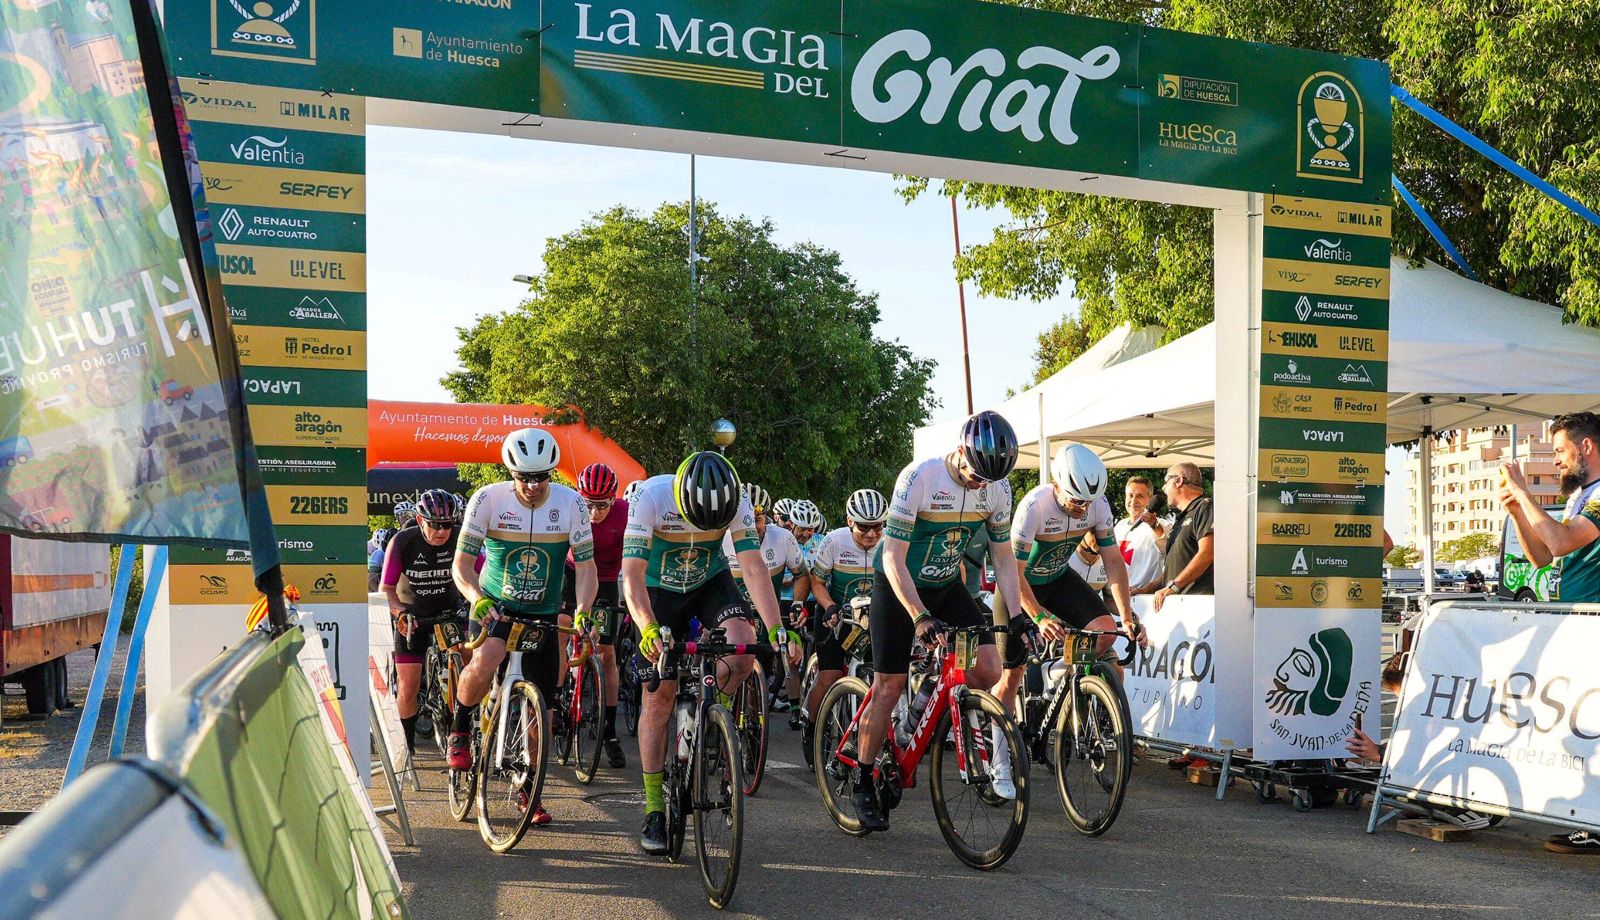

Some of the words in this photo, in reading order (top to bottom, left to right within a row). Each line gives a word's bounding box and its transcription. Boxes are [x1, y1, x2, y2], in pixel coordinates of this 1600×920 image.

[574, 2, 641, 47] La
[426, 31, 523, 55] Ayuntamiento
[426, 48, 443, 61] de
[447, 50, 500, 68] Huesca
[1184, 80, 1230, 93] DIPUTACIÓN
[200, 95, 257, 109] VIDAL
[1184, 89, 1195, 98] DE
[1196, 91, 1230, 102] HUESCA
[298, 103, 351, 122] MILAR
[230, 135, 305, 165] Valentia
[1223, 147, 1238, 155] BICI
[279, 182, 354, 200] SERFEY
[1286, 209, 1323, 219] VIDAL
[1349, 213, 1383, 227] MILAR
[253, 215, 311, 228] RENAULT
[1304, 238, 1352, 261] Valentia
[1335, 275, 1383, 288] SERFEY
[1317, 302, 1354, 311] RENAULT
[302, 343, 345, 356] Pedro
[1273, 372, 1312, 382] podoactiva
[1344, 402, 1373, 412] Pedro
[295, 412, 321, 423] alto
[379, 410, 478, 427] Ayuntamiento
[482, 414, 498, 425] de
[414, 427, 469, 443] Hacemos
[1303, 430, 1344, 442] LAPACA
[1338, 457, 1356, 465] alto
[289, 496, 349, 515] 226ERS
[1272, 523, 1311, 536] BARREU
[1334, 523, 1372, 538] 226ERS
[1316, 556, 1348, 566] turismo
[521, 641, 538, 650] 756
